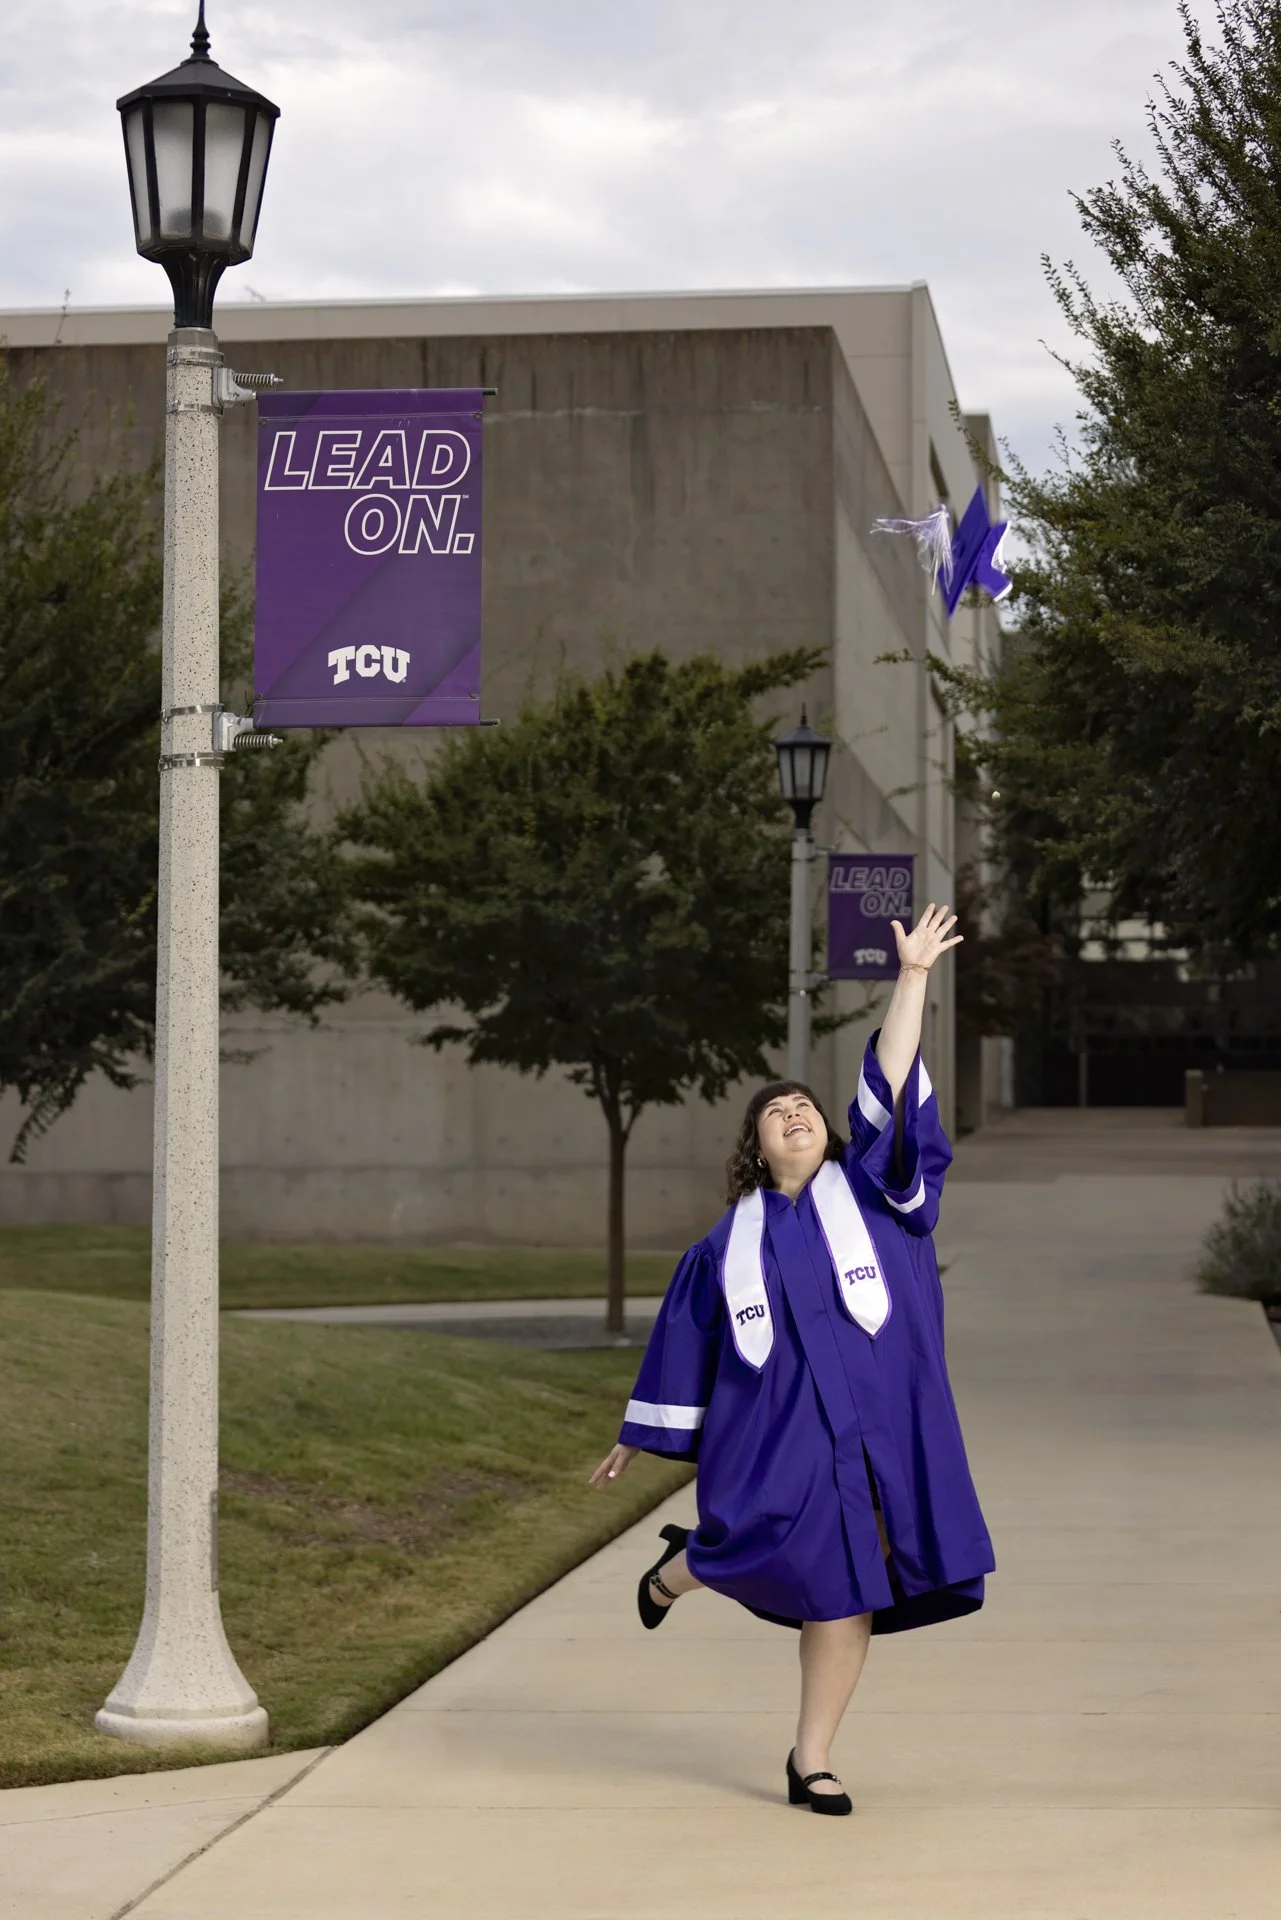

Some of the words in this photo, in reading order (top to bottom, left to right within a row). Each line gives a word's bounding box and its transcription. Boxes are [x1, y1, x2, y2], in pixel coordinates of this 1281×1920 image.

[264, 430, 471, 490] LEAD
[344, 493, 475, 555] ON.
[328, 644, 410, 685] TCU
[829, 867, 911, 893] LEAD
[854, 948, 888, 966] TCU
[844, 1266, 877, 1286] TCU
[736, 1304, 766, 1326] TCU
